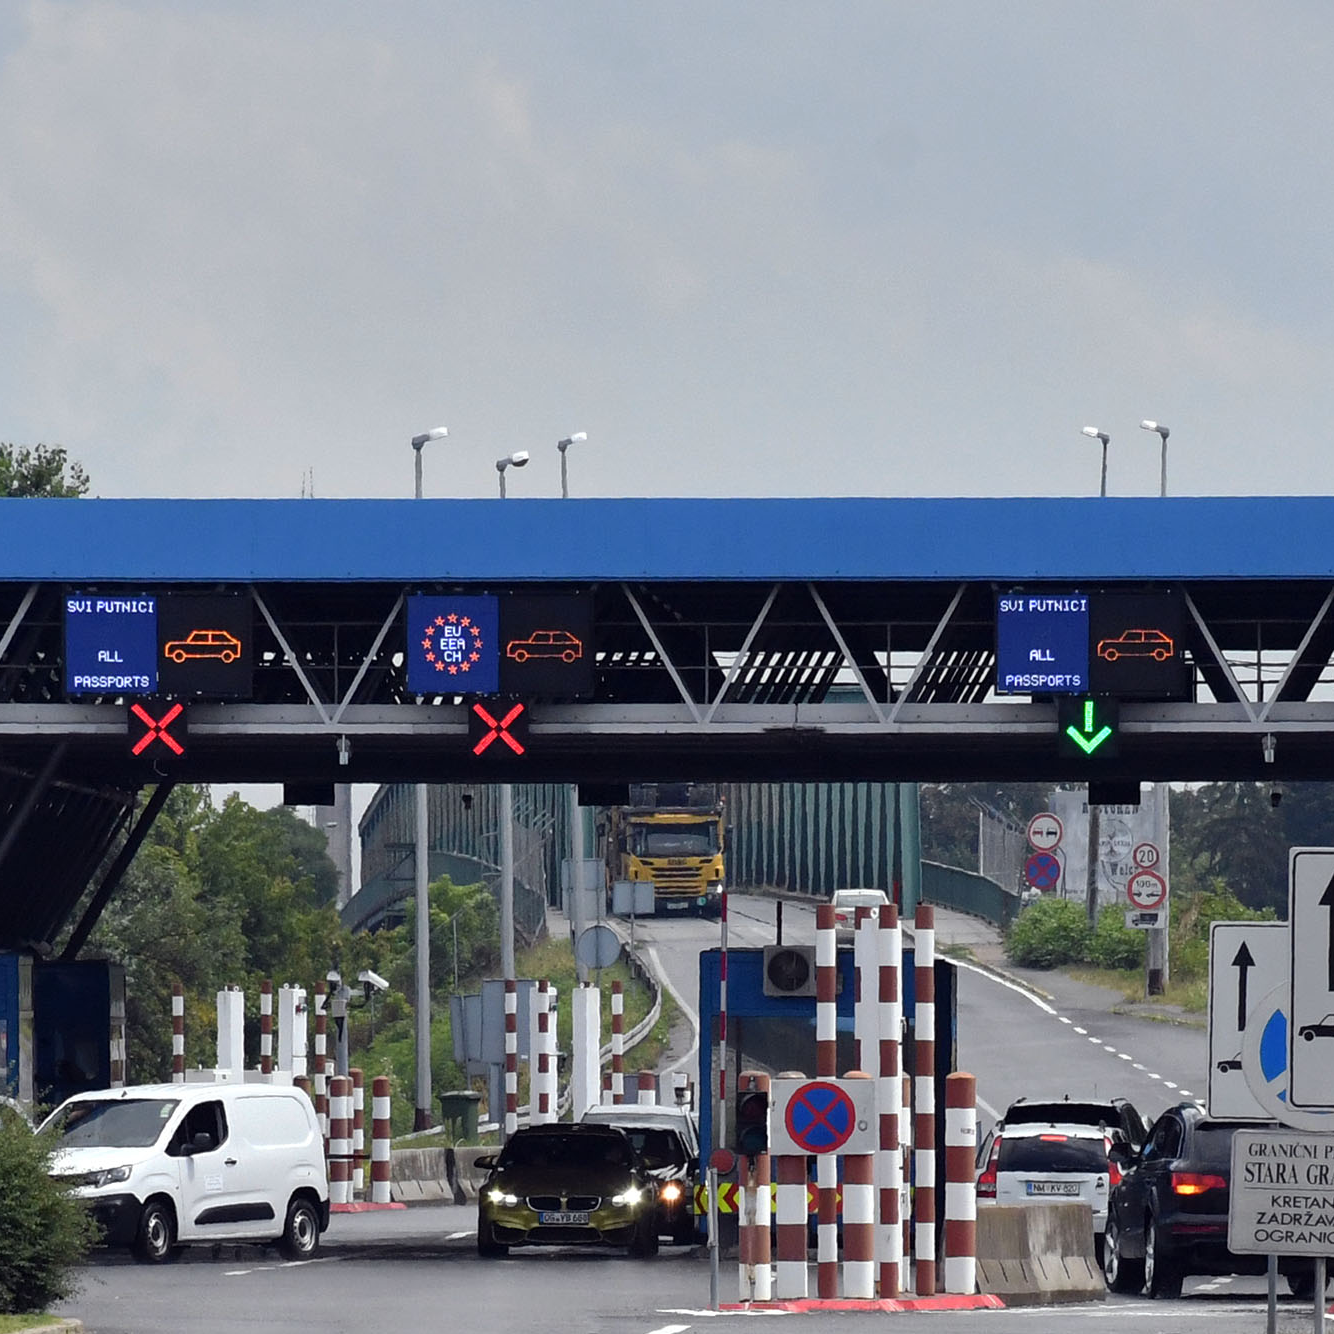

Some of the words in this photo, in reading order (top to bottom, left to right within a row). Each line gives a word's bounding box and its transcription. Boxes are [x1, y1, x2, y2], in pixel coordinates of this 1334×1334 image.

[67, 601, 92, 613] SVI
[96, 601, 153, 613] PUTNICI
[1000, 600, 1024, 612] SVI
[1029, 600, 1086, 612] PUTNICI
[444, 626, 462, 638] EU
[440, 638, 466, 650] EEA
[98, 650, 124, 662] ALL
[444, 651, 462, 662] CH
[1029, 649, 1055, 661] ALL
[74, 676, 150, 688] PASSPORTS
[1005, 675, 1081, 686] PASSPORTS
[1139, 850, 1154, 863] 20
[1244, 1162, 1298, 1184] STARA
